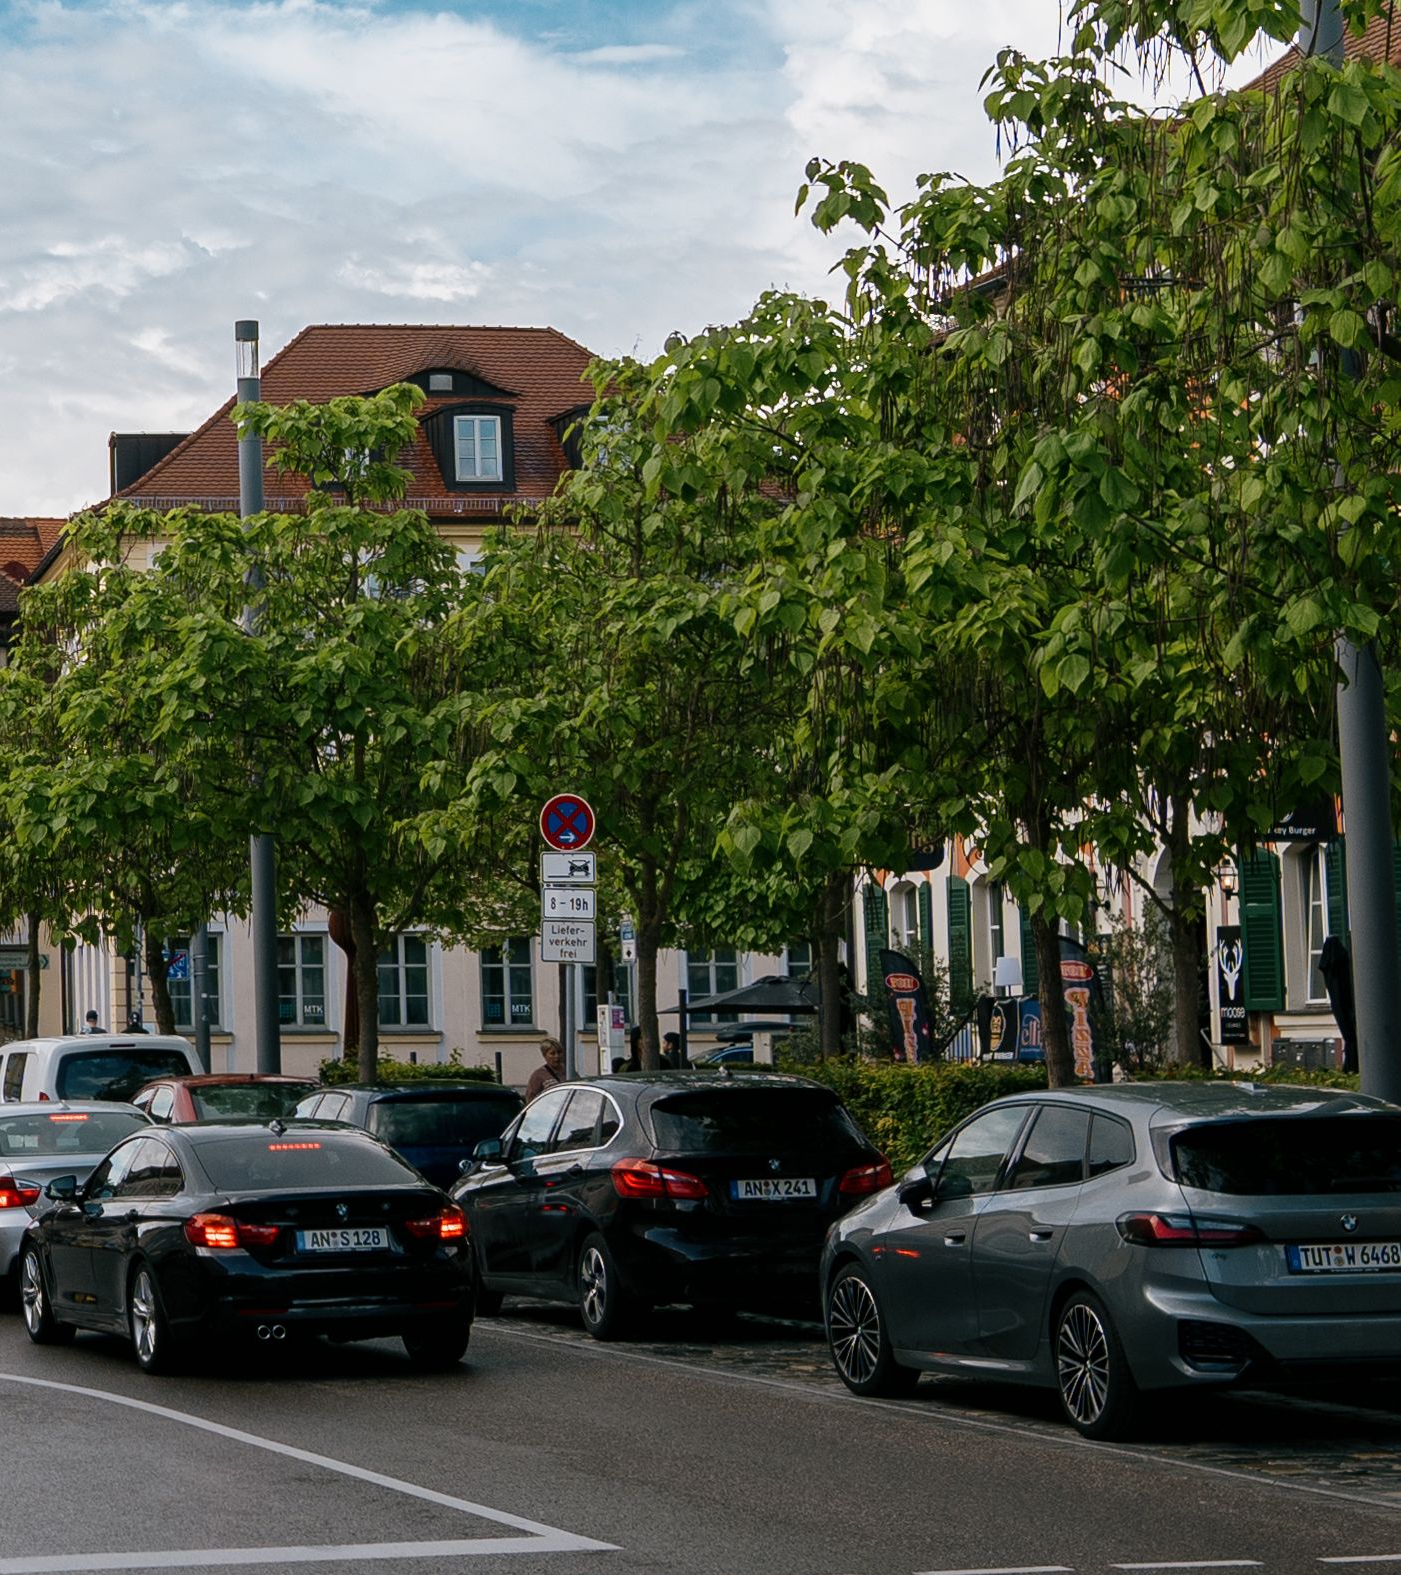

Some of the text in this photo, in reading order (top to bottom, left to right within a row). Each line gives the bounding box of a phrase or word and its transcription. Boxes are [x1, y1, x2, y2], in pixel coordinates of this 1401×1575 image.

[1288, 825, 1316, 836] Burger
[550, 897, 557, 910] 8
[569, 897, 589, 911] 19h
[551, 925, 585, 935] Liefer-
[549, 937, 588, 947] verkehr
[560, 948, 577, 958] frei
[304, 1004, 324, 1014] MTK
[511, 1004, 531, 1014] MTK
[1220, 1006, 1246, 1019] moose
[744, 1180, 811, 1196] AN X 241
[311, 1230, 381, 1247] AN S 128
[1301, 1243, 1401, 1267] TUT W 6468
